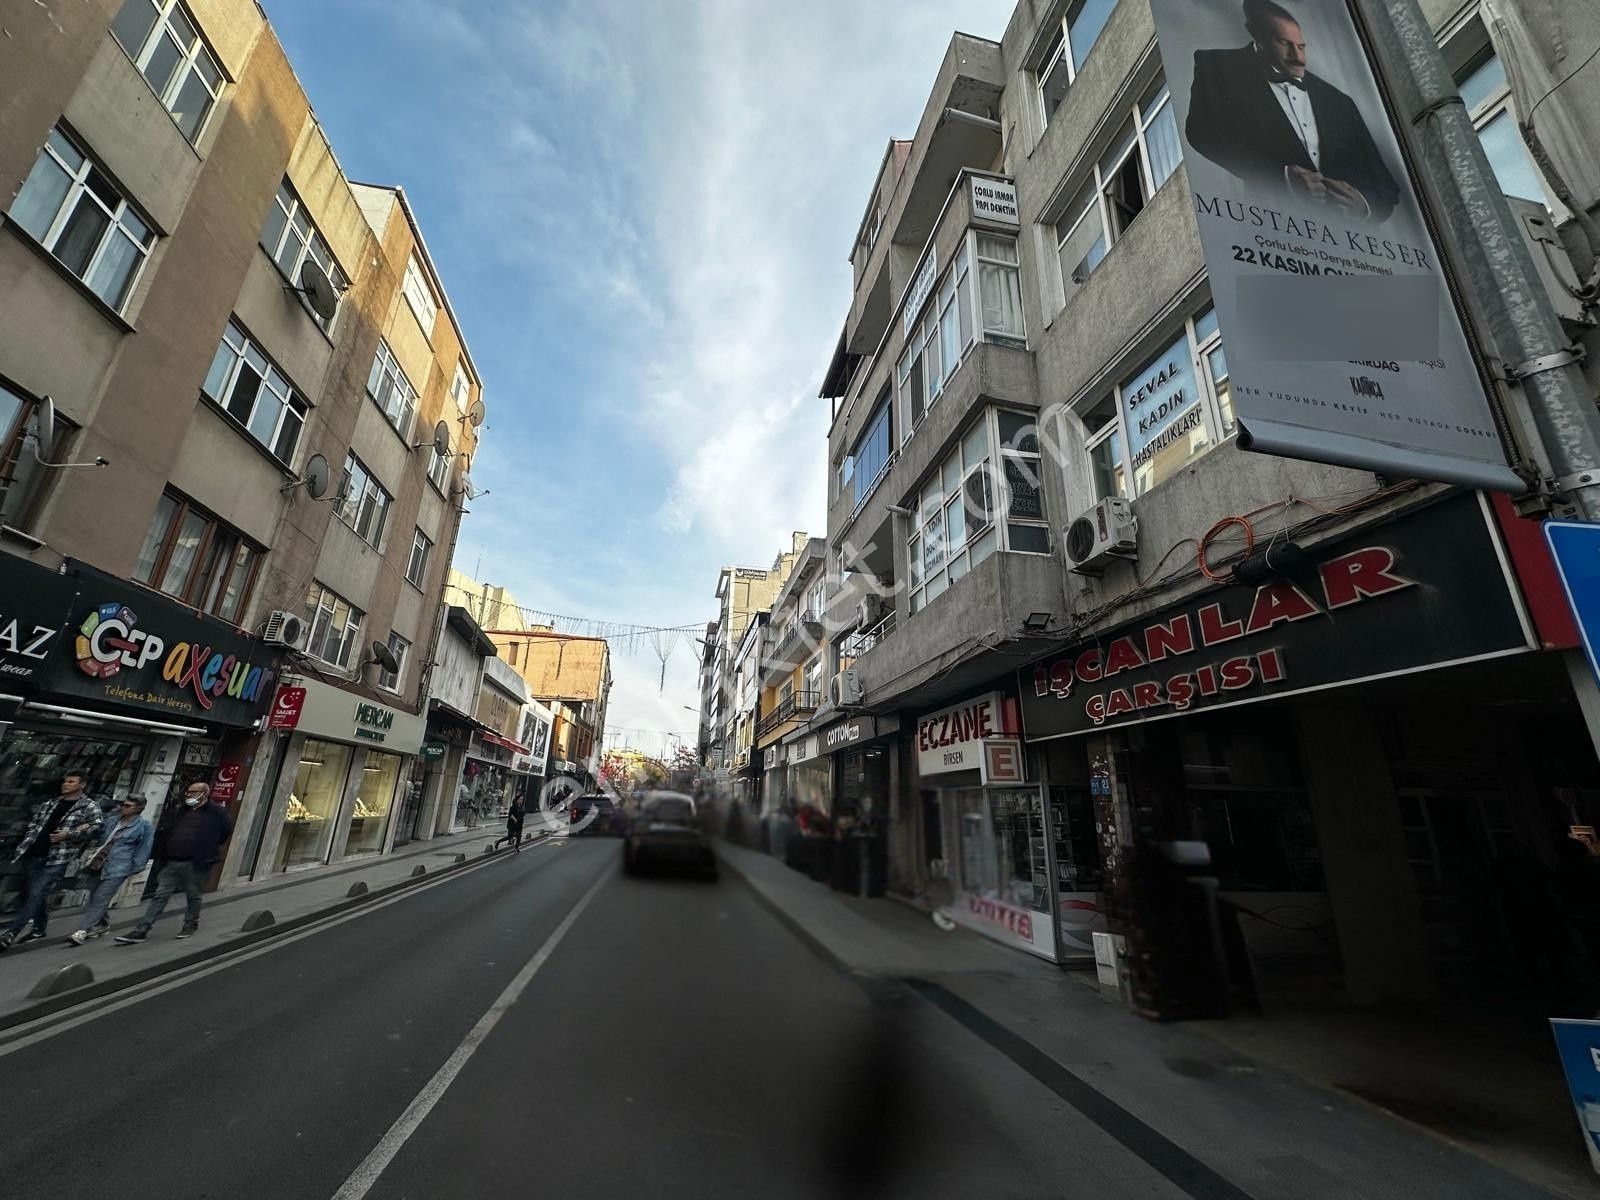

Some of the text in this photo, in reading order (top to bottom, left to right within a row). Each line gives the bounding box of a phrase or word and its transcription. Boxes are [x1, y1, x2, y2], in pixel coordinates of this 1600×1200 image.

[975, 202, 1017, 216] YAPI DENETİM
[1195, 192, 1433, 270] MUSTAFA KESER
[1231, 245, 1258, 265] 22
[1259, 251, 1320, 275] KASIM
[1254, 235, 1287, 251] Çorlu
[1320, 251, 1351, 268] Derya
[1129, 361, 1179, 410] SEVAL
[1236, 386, 1260, 396] HER
[1268, 391, 1327, 407] YUDUMDA
[1139, 389, 1184, 434] KADIN
[1135, 408, 1201, 466] HASTALIKLARI
[1034, 546, 1420, 699] İŞCANLAR
[91, 618, 274, 710] CEP axesuar
[1085, 647, 1287, 725] ÇARŞISI
[354, 701, 394, 730] MERCAN
[827, 723, 850, 746] COTTON
[918, 701, 993, 752] ECZANE
[943, 750, 964, 766] BİRSEN
[991, 747, 1015, 777] E
